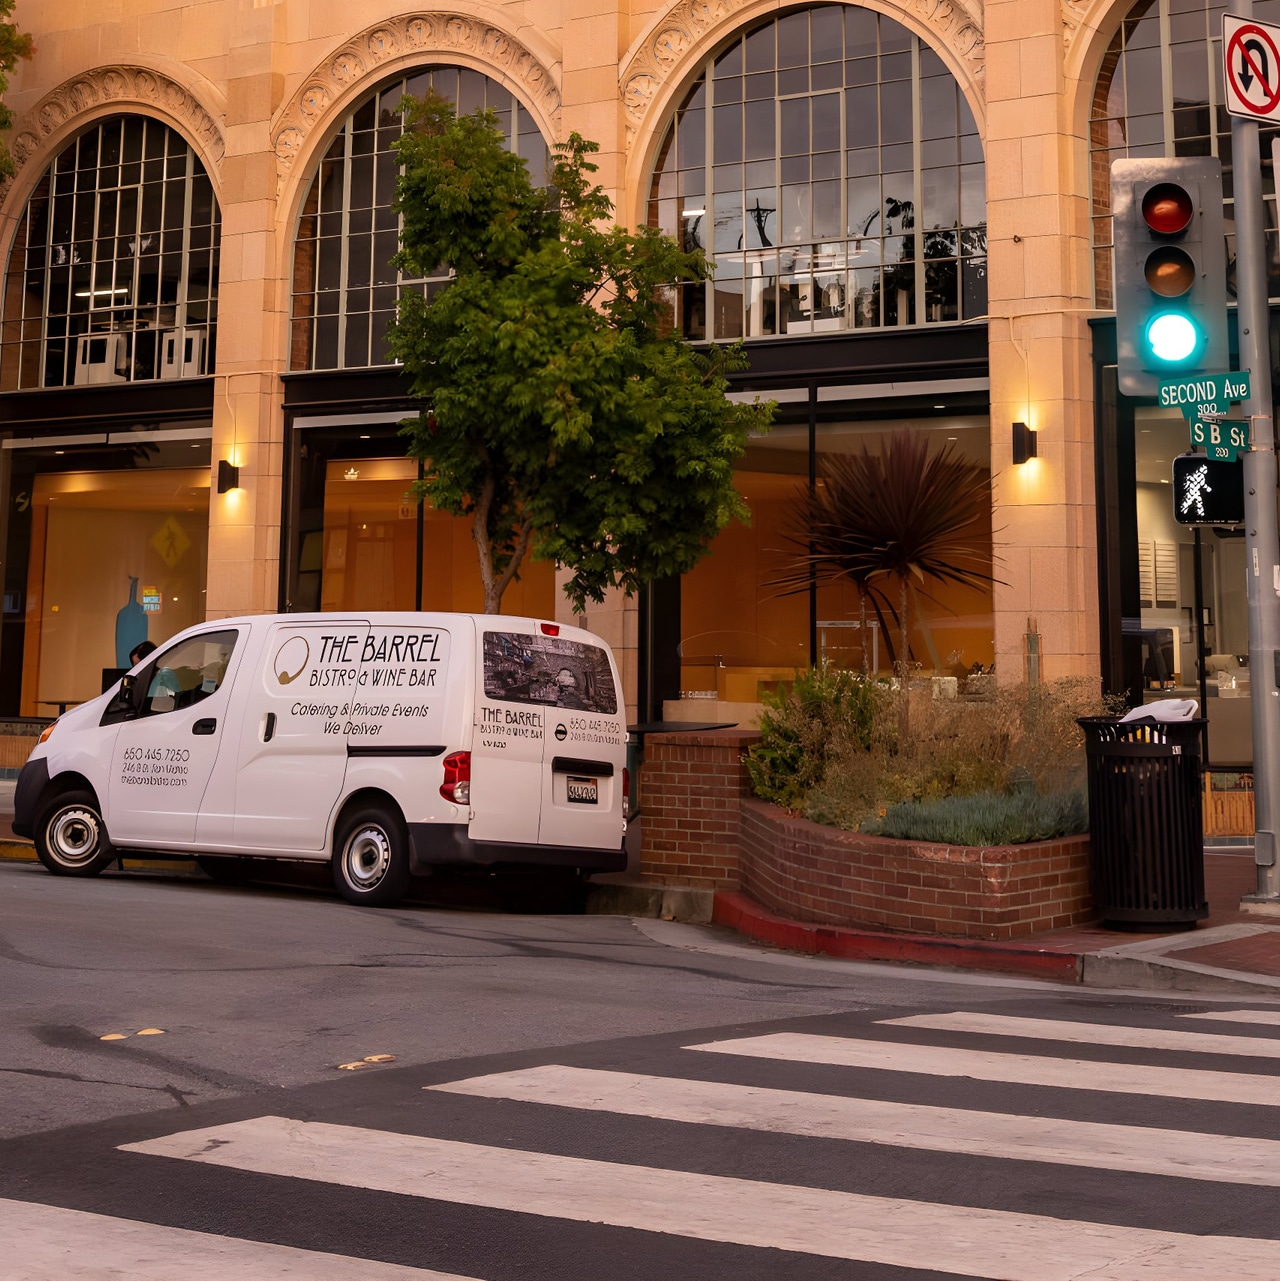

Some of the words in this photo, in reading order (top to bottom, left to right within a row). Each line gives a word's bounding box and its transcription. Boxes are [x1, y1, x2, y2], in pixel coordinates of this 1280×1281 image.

[1161, 381, 1217, 406] SECOND
[1224, 379, 1248, 399] Ave
[1194, 423, 1205, 443] S
[1210, 424, 1221, 445] B
[1230, 427, 1245, 447] St
[320, 636, 359, 663] THE
[360, 634, 441, 663] BARREL
[310, 669, 357, 687] BISTRO
[372, 668, 407, 687] WINE
[408, 668, 437, 687] BAR
[291, 702, 339, 719] Catering
[340, 702, 350, 716] &
[351, 702, 390, 717] Private
[391, 703, 429, 718] Events
[481, 707, 502, 723] THE
[505, 710, 543, 728] BARREL
[323, 721, 341, 735] We
[342, 721, 383, 736] Deliver
